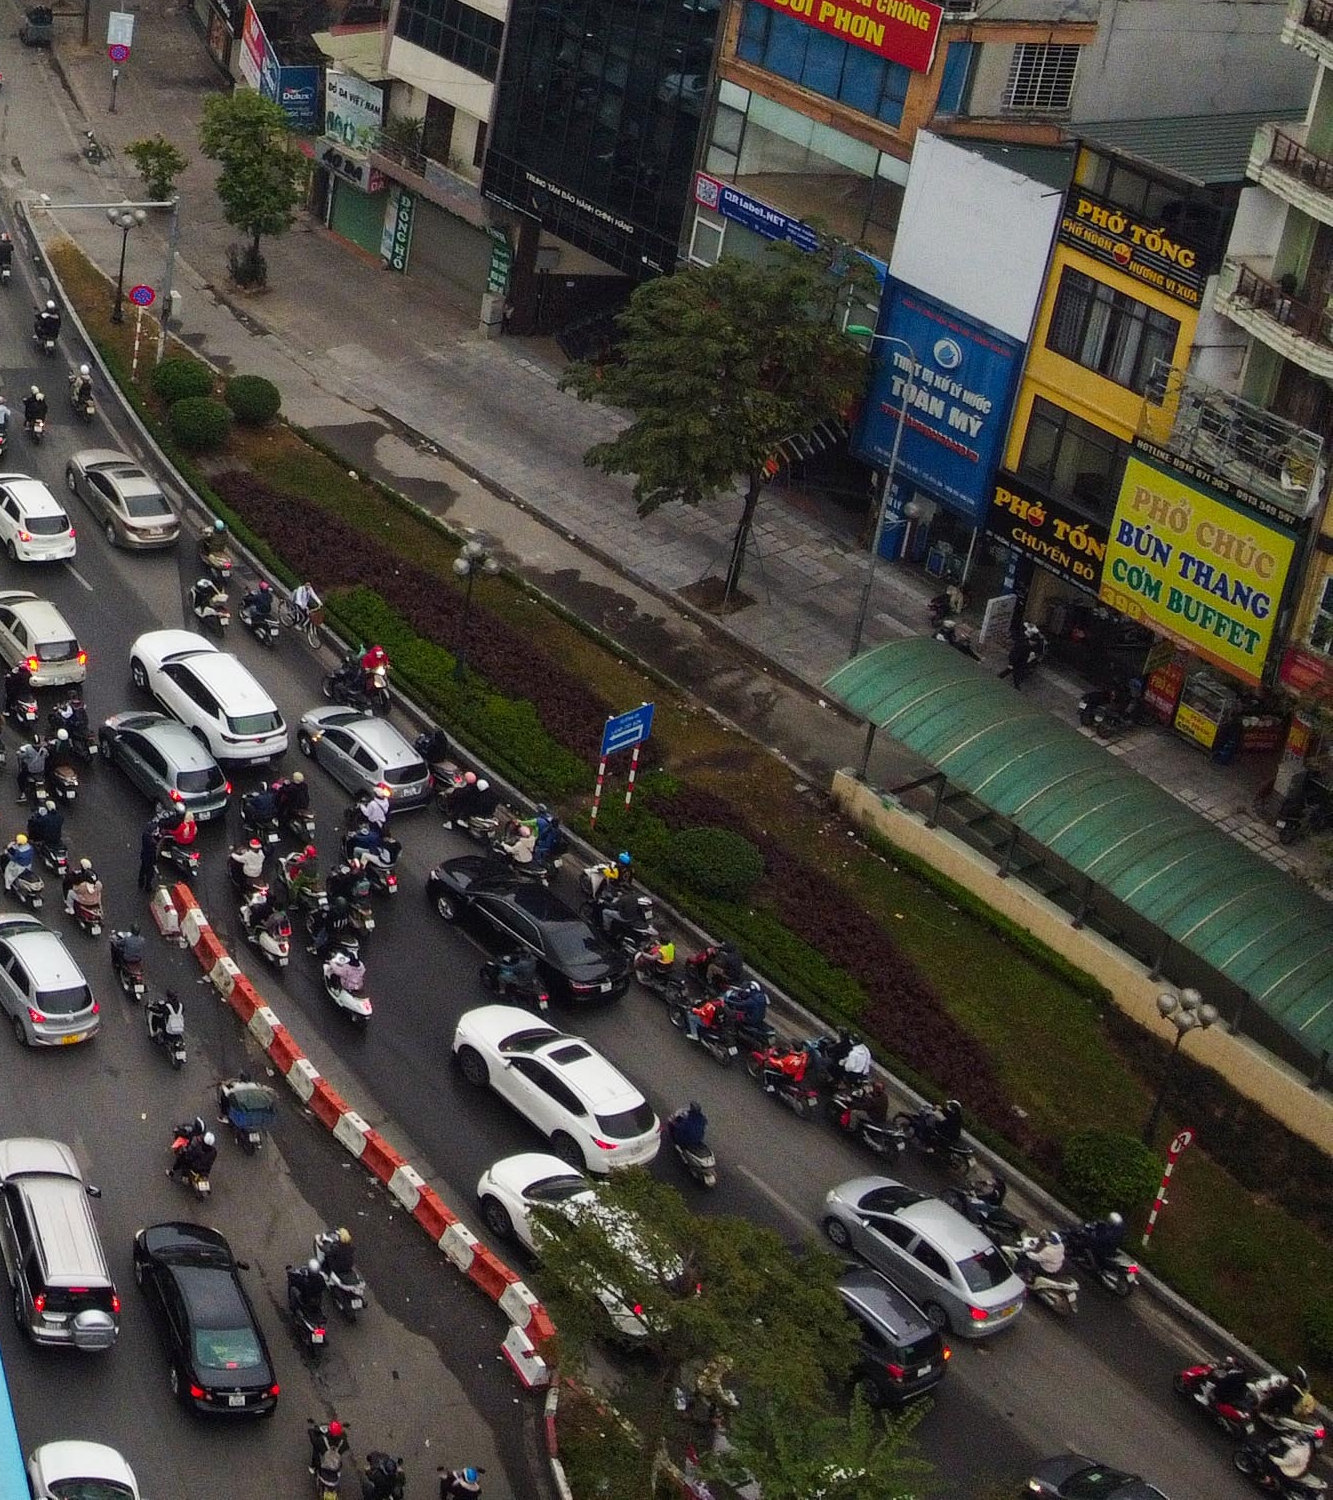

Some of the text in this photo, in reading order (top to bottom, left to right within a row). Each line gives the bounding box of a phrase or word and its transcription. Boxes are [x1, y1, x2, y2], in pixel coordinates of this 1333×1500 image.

[282, 91, 310, 101] Dulux
[525, 171, 547, 188] TRUNG
[547, 183, 561, 197] TÂM
[561, 190, 576, 204] BẢO
[739, 196, 786, 229] Label.NET
[1062, 218, 1083, 236] PHỞ
[1083, 228, 1113, 251] NGON
[1128, 260, 1166, 288] HƯƠNG
[1176, 284, 1199, 303] XƯA
[1076, 198, 1196, 268] PHỞ TỐNG
[891, 374, 946, 419] TOÀN
[948, 406, 984, 438] MỸ
[892, 352, 922, 377] THIT
[949, 381, 963, 398] LÝ
[962, 388, 993, 414] NƯỚC
[993, 486, 1108, 561] PHỞ TỐN
[1011, 527, 1071, 568] CHUYÊN
[1073, 561, 1095, 581] BÒ
[1133, 484, 1276, 580] PHỞ CHÚC
[1116, 518, 1173, 568] BÚN
[1179, 551, 1271, 620] THANG
[1111, 557, 1163, 604] CƠM
[1166, 585, 1262, 656] BUFFET
